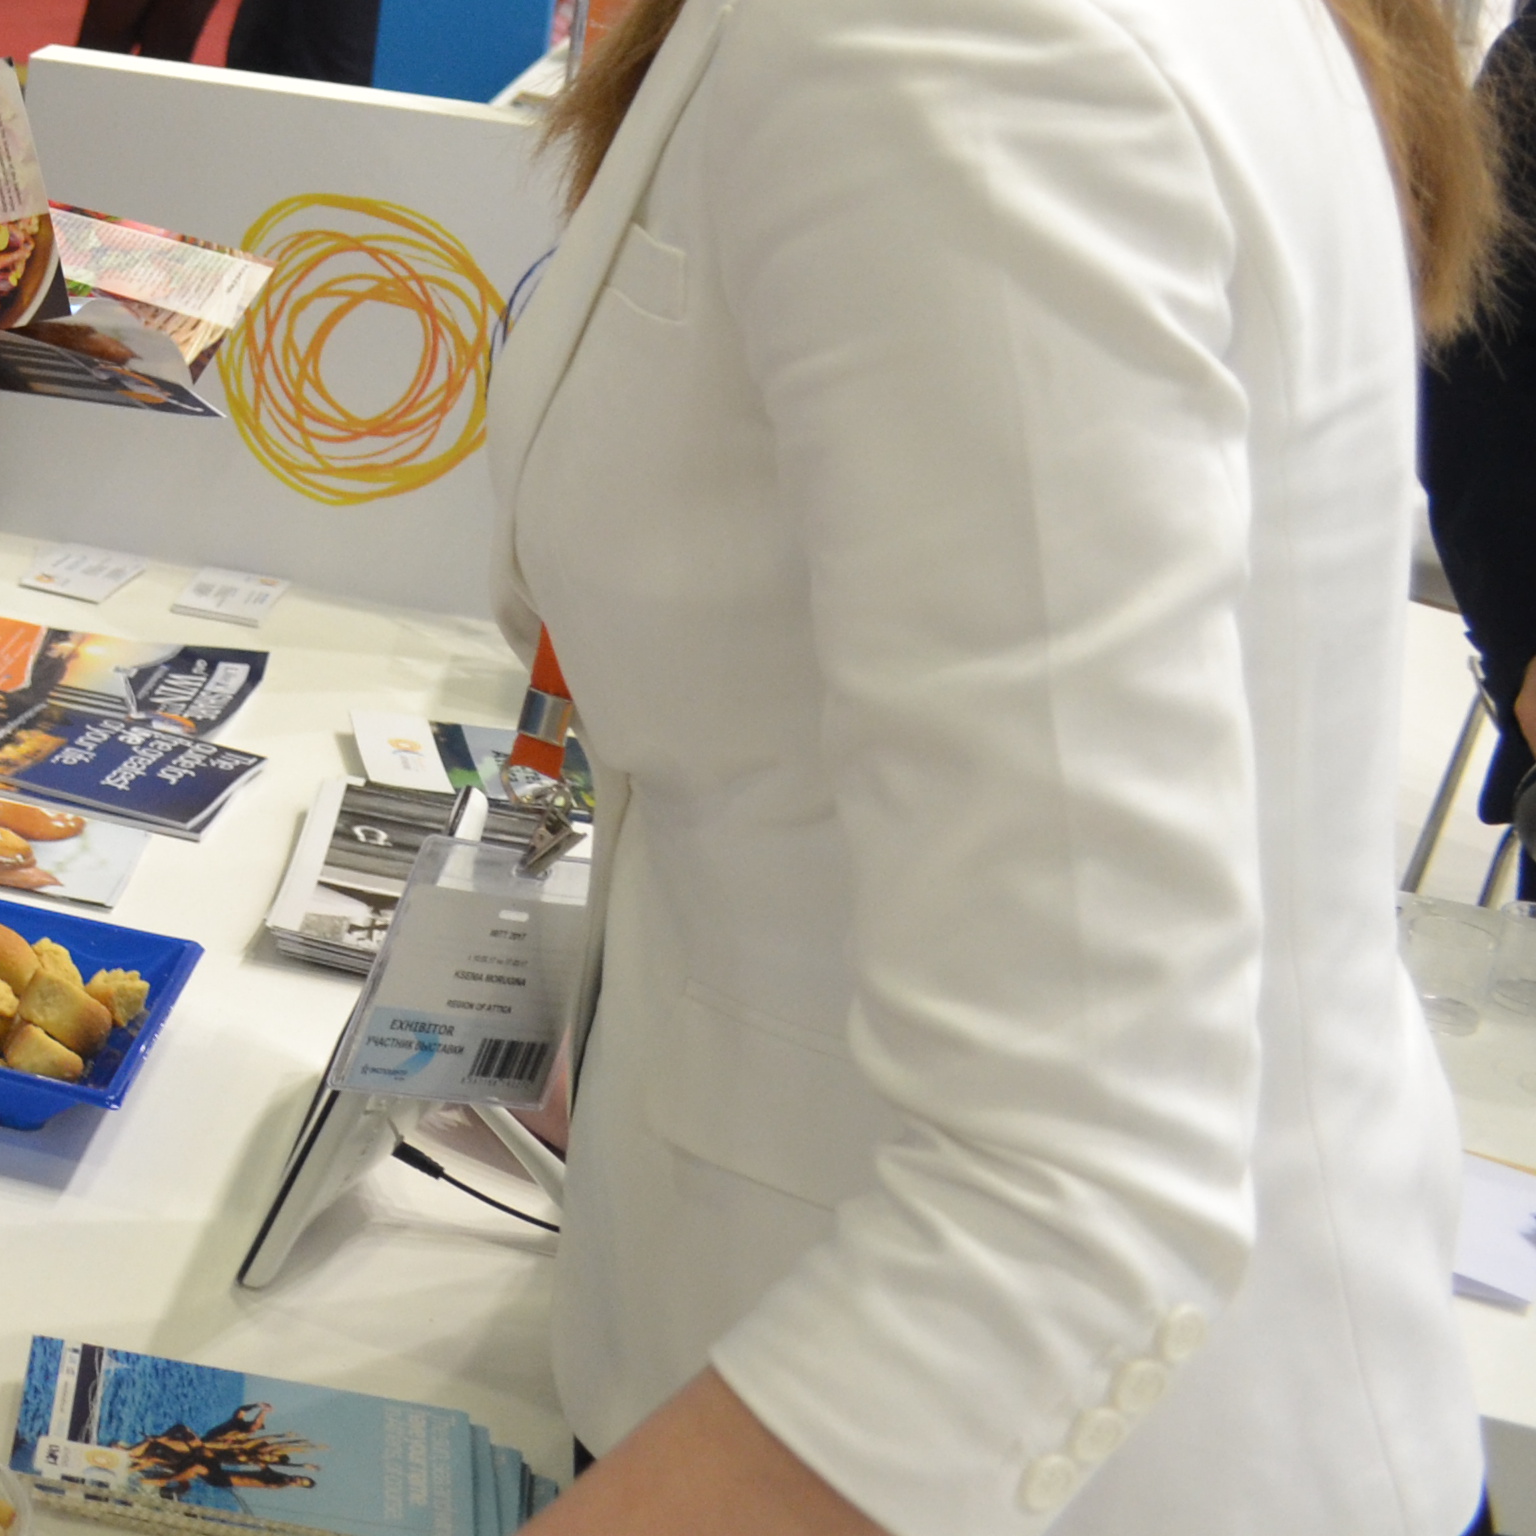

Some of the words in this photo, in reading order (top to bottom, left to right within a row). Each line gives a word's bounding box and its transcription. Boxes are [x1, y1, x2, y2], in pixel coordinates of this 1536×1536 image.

[219, 753, 259, 771] The
[157, 763, 196, 786] for
[389, 1019, 455, 1036] EXHIBITOR
[365, 1036, 414, 1052] УЧАСТНИК
[414, 1041, 464, 1056] ВЫСТАВКИ
